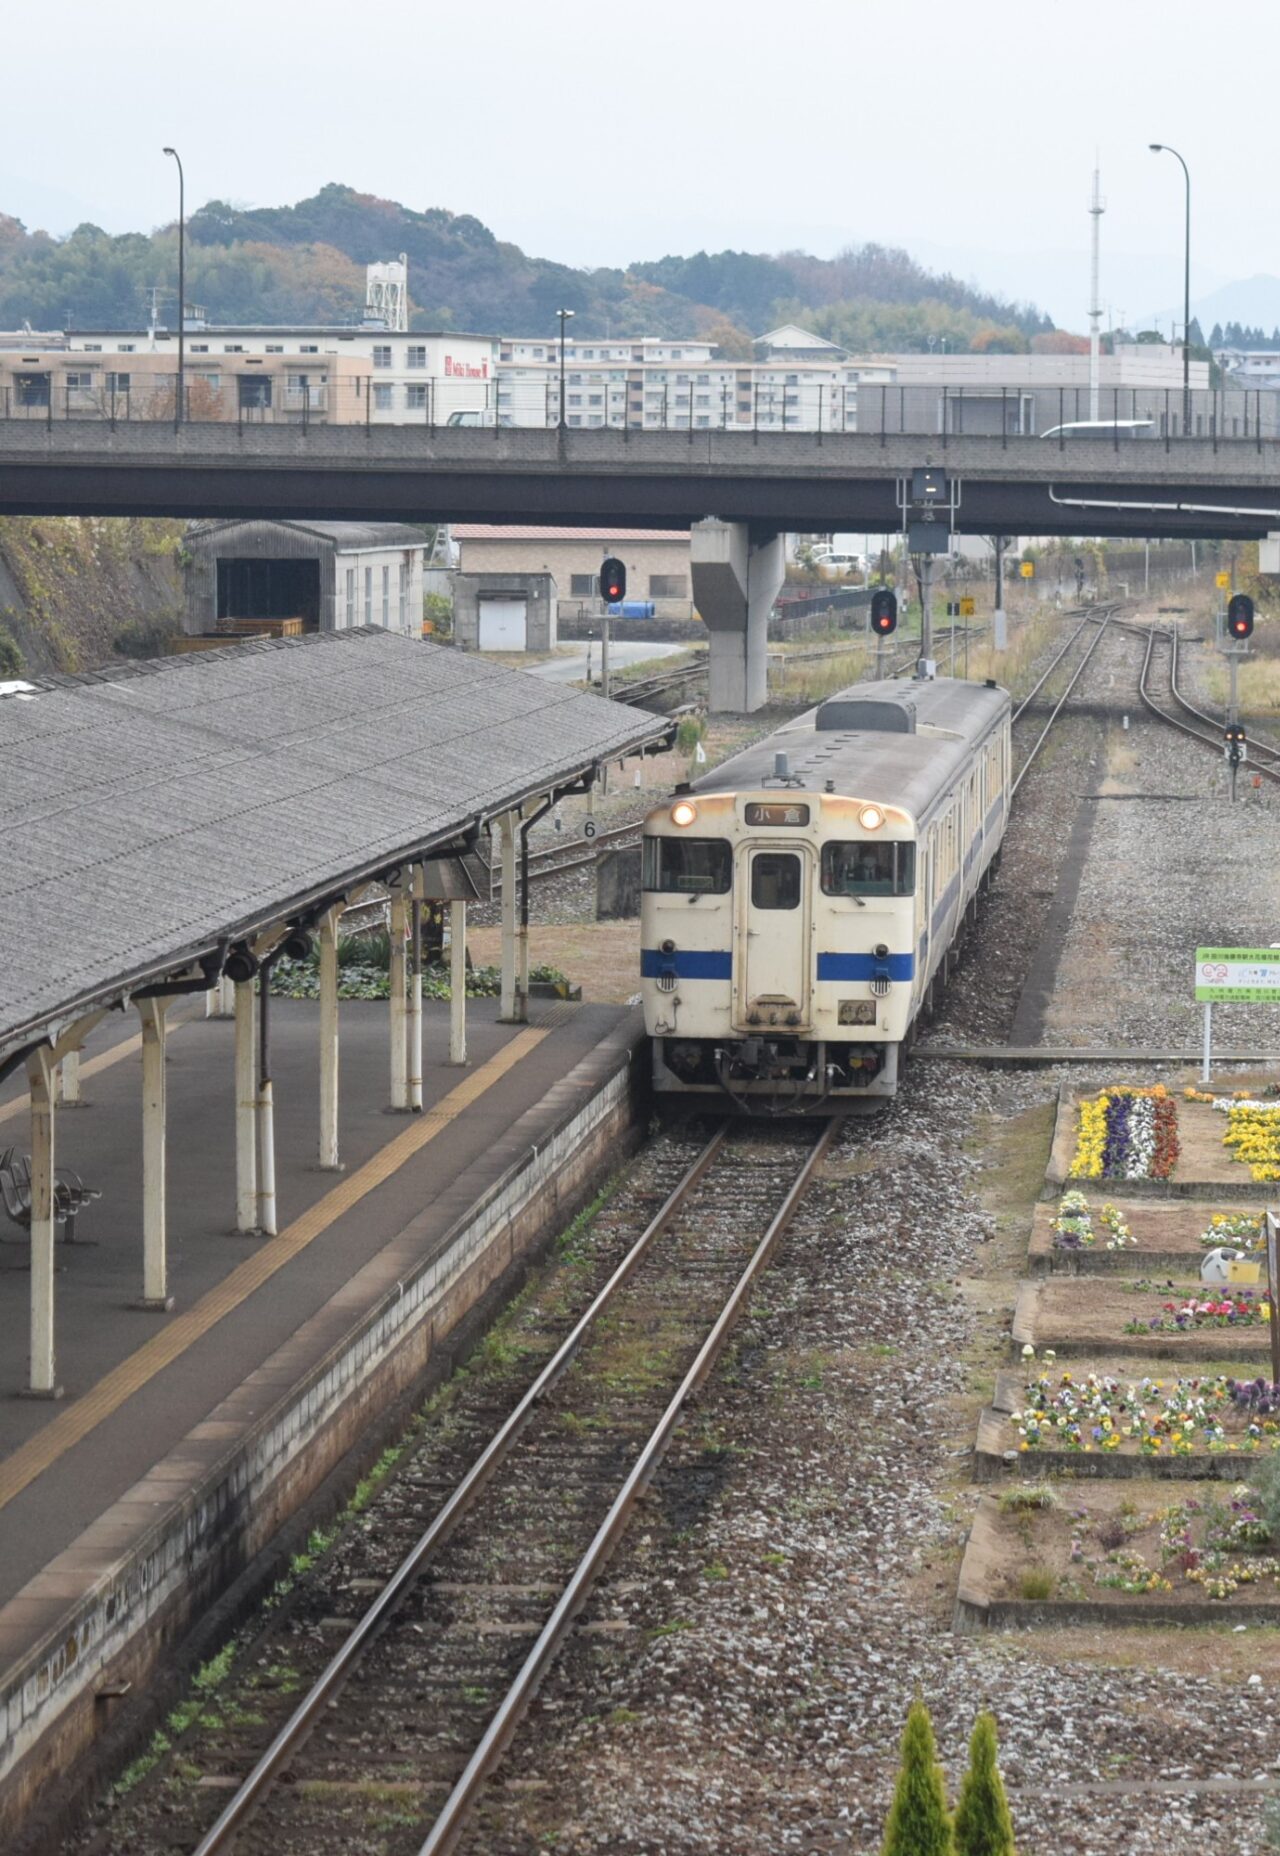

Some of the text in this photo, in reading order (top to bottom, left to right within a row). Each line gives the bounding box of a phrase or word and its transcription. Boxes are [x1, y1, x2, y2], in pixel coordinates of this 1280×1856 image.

[754, 807, 801, 823] 小倉
[584, 821, 596, 837] 6
[389, 868, 402, 888] 2
